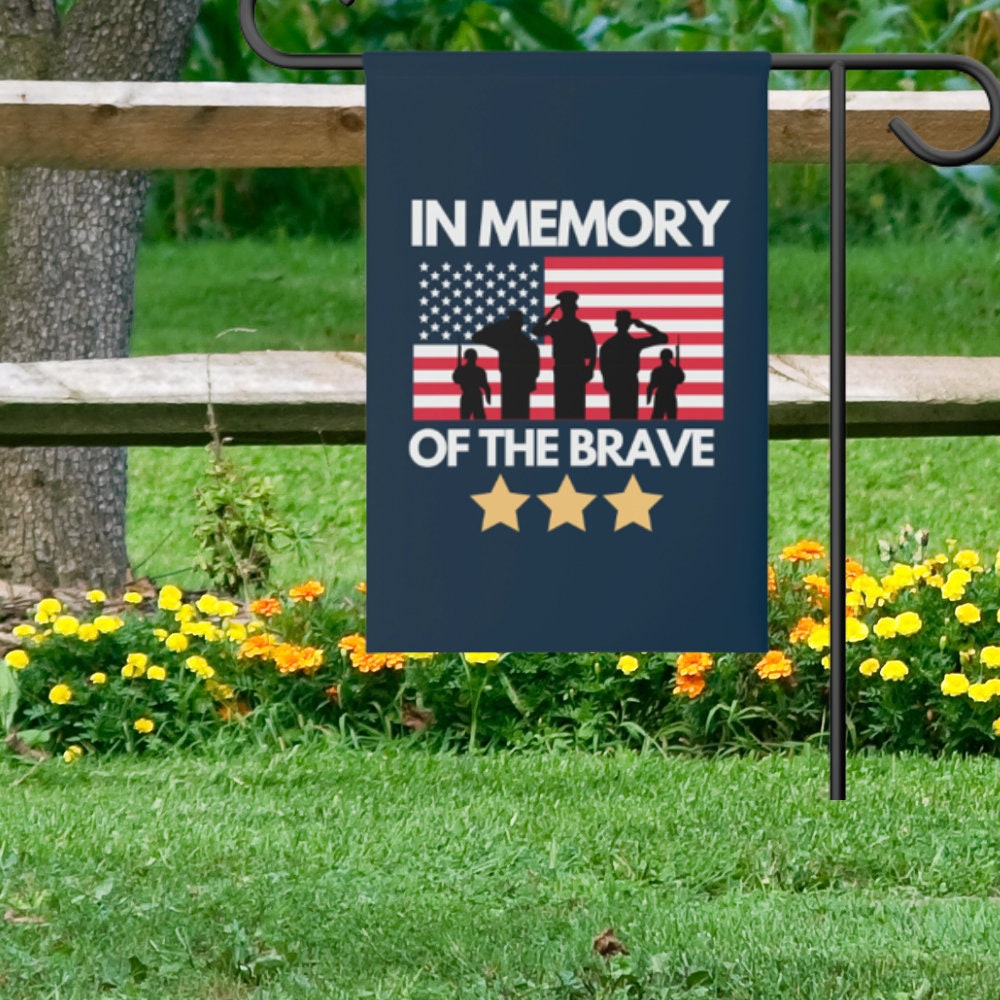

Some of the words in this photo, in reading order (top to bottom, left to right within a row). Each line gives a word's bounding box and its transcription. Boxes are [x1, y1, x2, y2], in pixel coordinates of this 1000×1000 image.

[411, 199, 466, 247] IN
[478, 199, 730, 248] MEMORY
[408, 428, 470, 468] OF
[478, 428, 559, 467] THE
[570, 428, 715, 467] BRAVE
